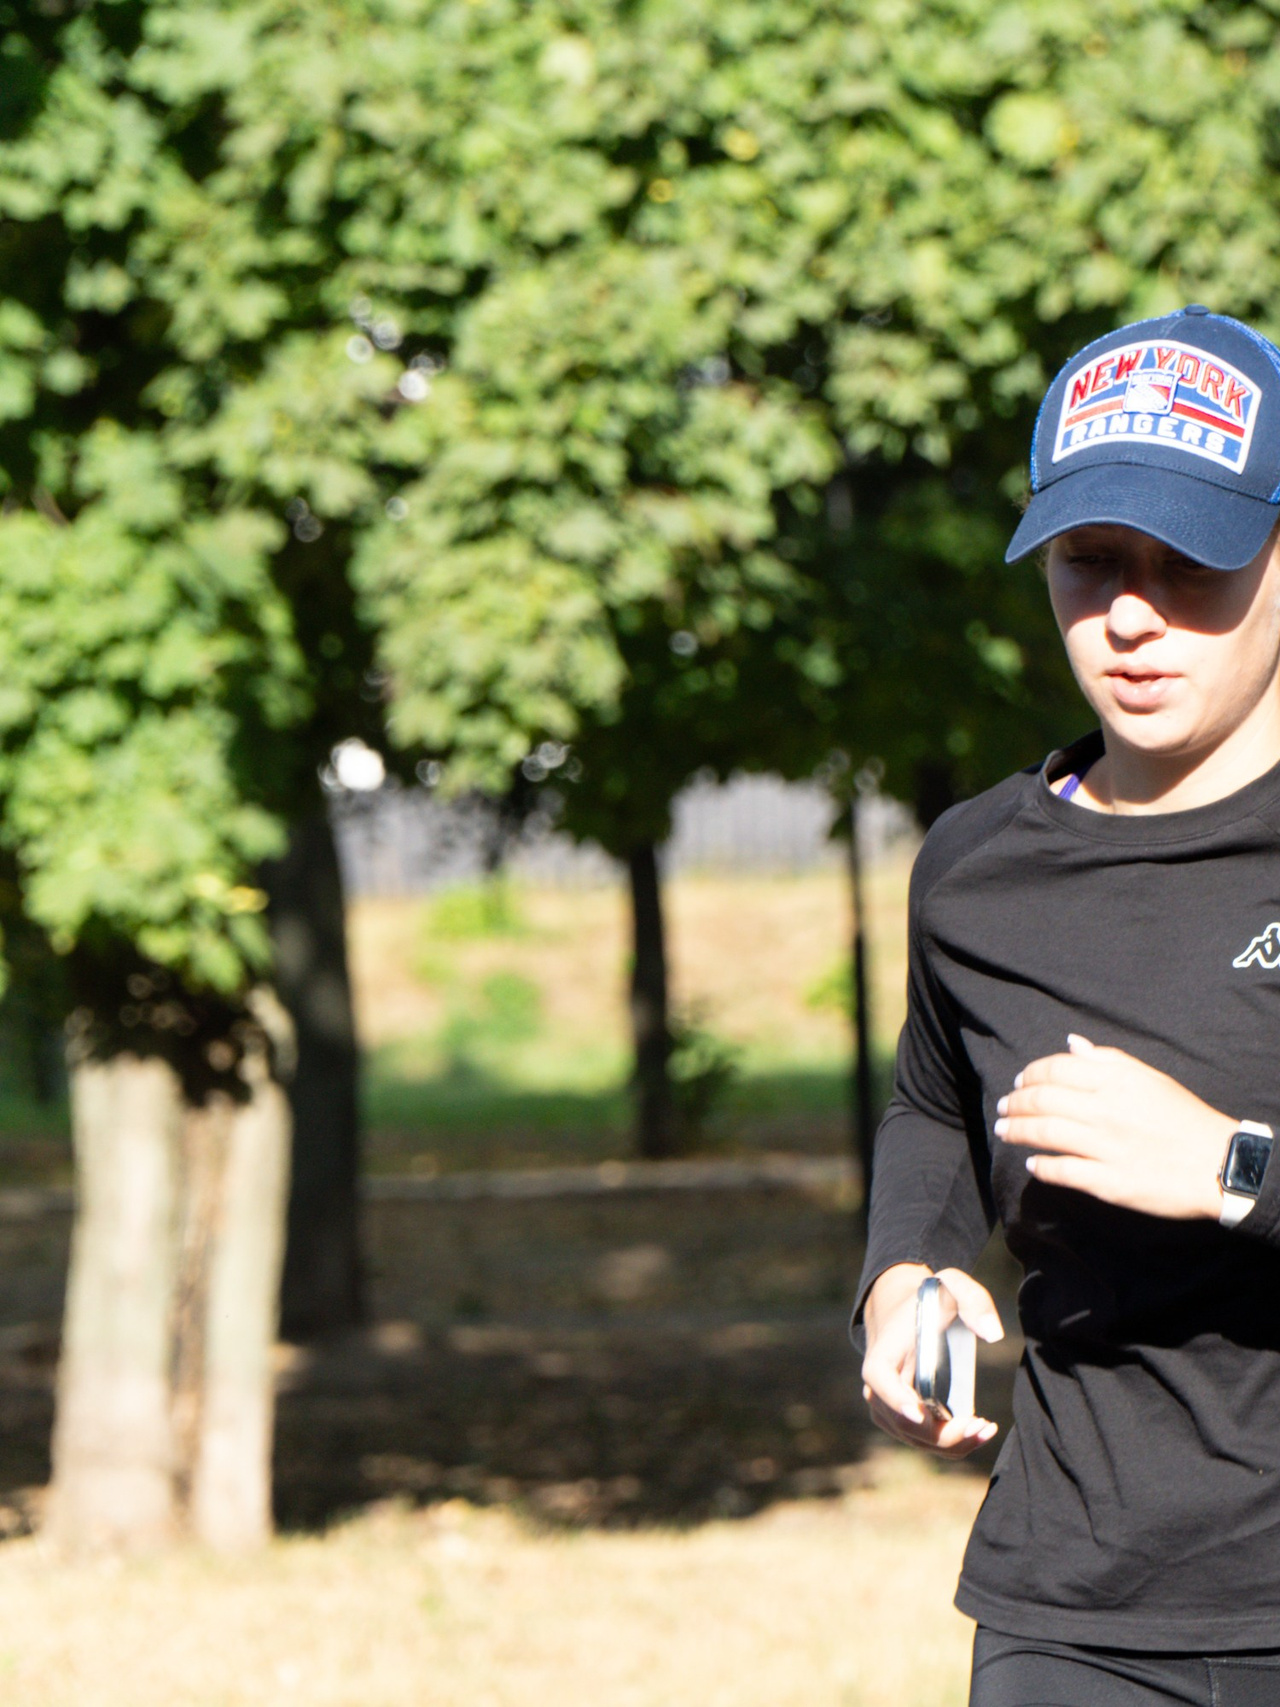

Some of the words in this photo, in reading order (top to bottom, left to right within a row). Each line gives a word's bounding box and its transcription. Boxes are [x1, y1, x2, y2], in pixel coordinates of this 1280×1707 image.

[1069, 348, 1145, 409] NEW
[1154, 348, 1248, 419] YORK
[1069, 414, 1226, 454] RANGERS
